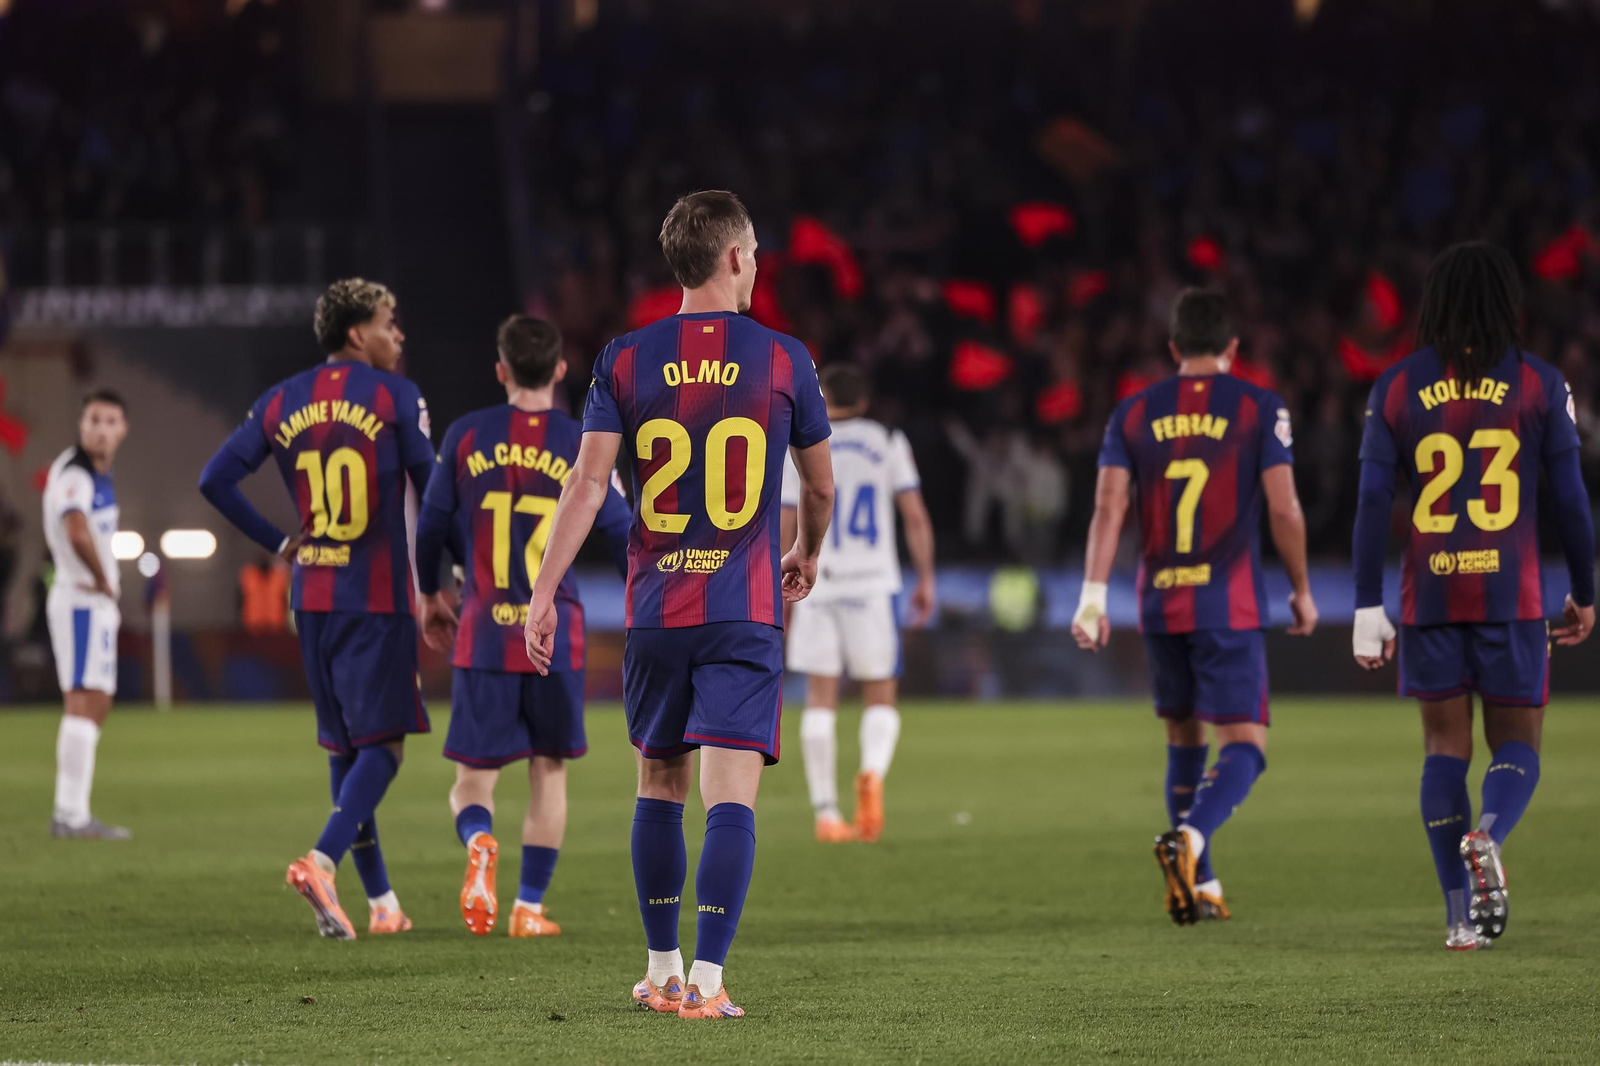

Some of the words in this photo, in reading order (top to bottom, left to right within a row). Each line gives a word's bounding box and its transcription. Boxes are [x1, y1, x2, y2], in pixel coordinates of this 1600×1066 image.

[663, 359, 740, 387] OLMO
[275, 400, 328, 449] LAMINE
[331, 399, 384, 442] YAMAL
[1152, 413, 1229, 442] FERRAN
[295, 446, 369, 541] 10
[466, 450, 496, 477] M.
[636, 416, 767, 534] 20
[1412, 428, 1521, 534] 23
[480, 491, 559, 589] 17
[1164, 458, 1210, 554] 7
[686, 548, 730, 560] UNHCR
